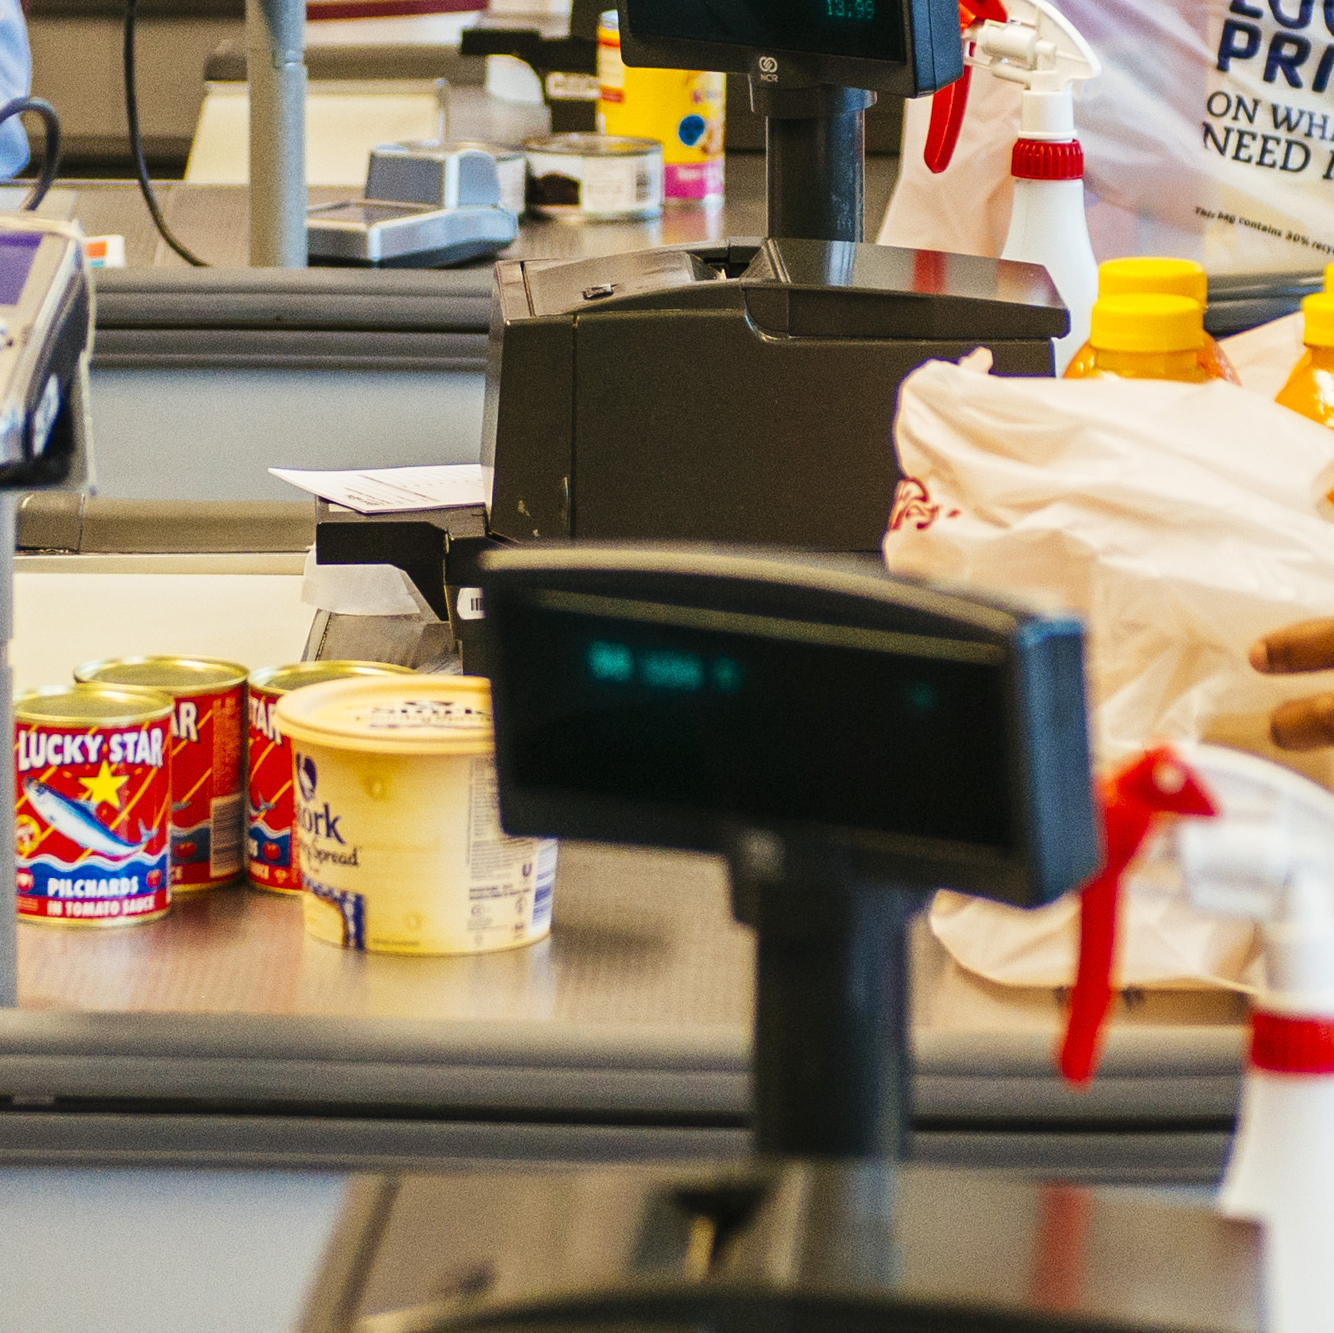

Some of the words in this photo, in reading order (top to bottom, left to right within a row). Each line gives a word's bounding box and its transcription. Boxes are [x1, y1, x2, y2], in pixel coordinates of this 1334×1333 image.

[760, 73, 779, 82] NCR
[1206, 90, 1262, 125] ON
[1201, 121, 1312, 174] NEED
[1195, 206, 1216, 219] This
[1217, 210, 1236, 225] bag
[1238, 217, 1283, 238] contains
[17, 729, 105, 772] LUCKY
[108, 726, 164, 769] STAR
[298, 802, 347, 846] ork
[46, 875, 140, 899] PILCHARDS
[46, 899, 64, 917] IN
[64, 900, 121, 918] TOMATO
[121, 894, 157, 916] SAUCE
